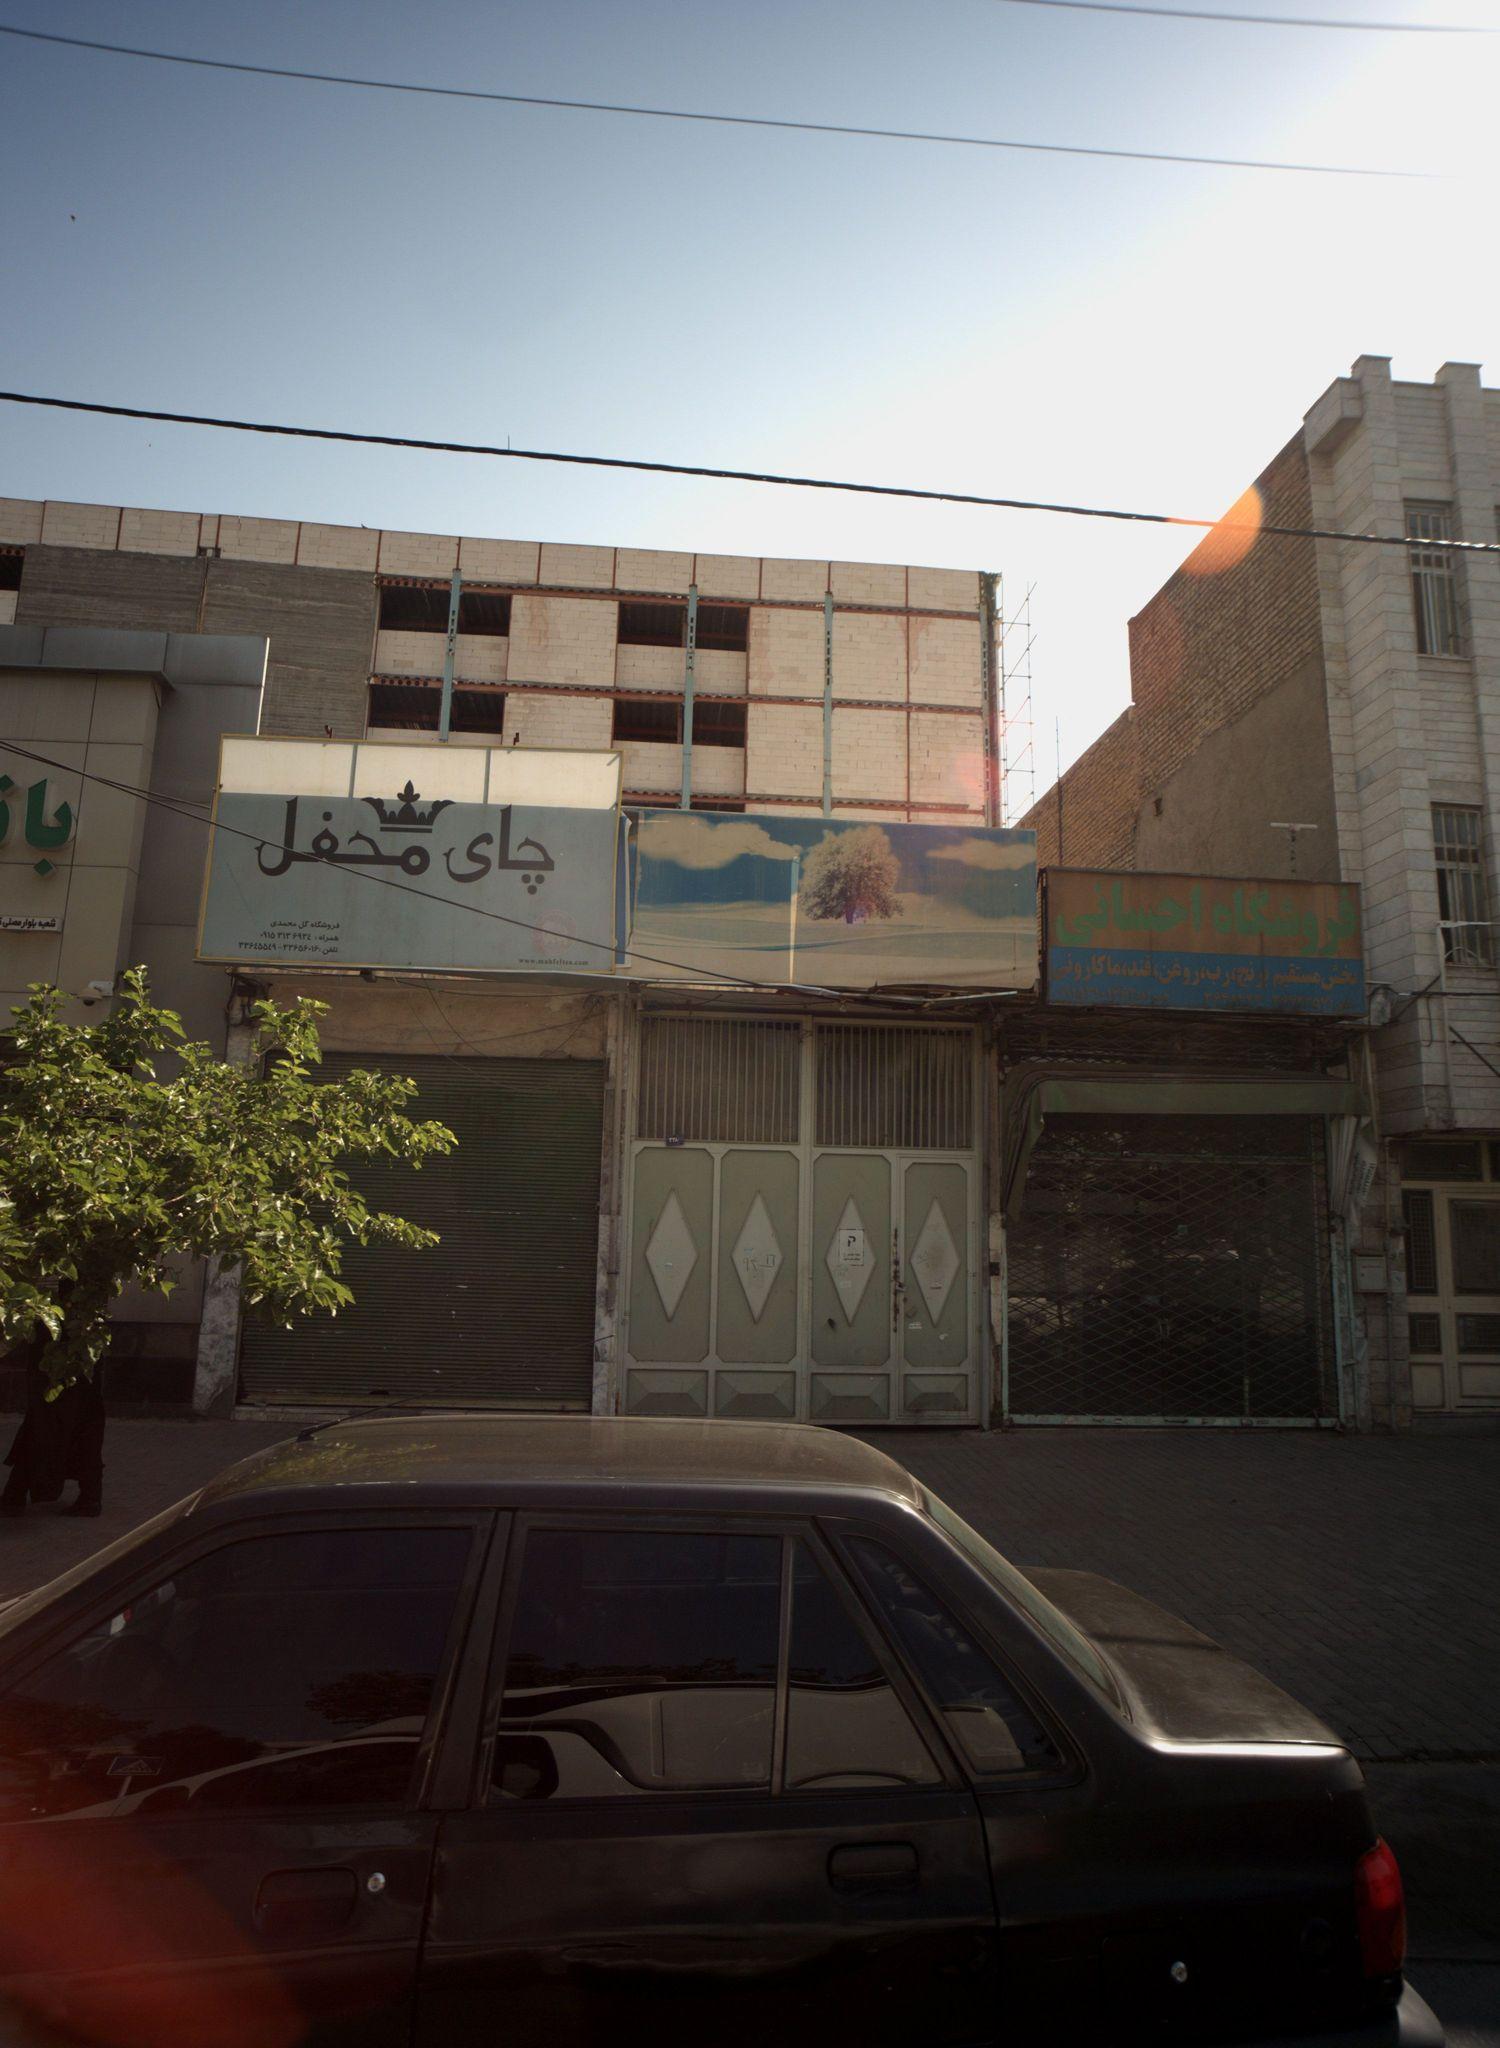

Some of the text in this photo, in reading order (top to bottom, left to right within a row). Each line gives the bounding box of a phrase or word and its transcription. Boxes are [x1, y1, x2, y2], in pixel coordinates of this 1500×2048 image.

[254, 795, 555, 895] چای محفل
[20, 918, 37, 929] بلوار
[38, 918, 56, 929] شعبه
[1055, 880, 1359, 956] فروشگاه احسانی
[270, 920, 340, 930] فروشگاه گل محمدی
[260, 931, 276, 939] ۰۹۱۵
